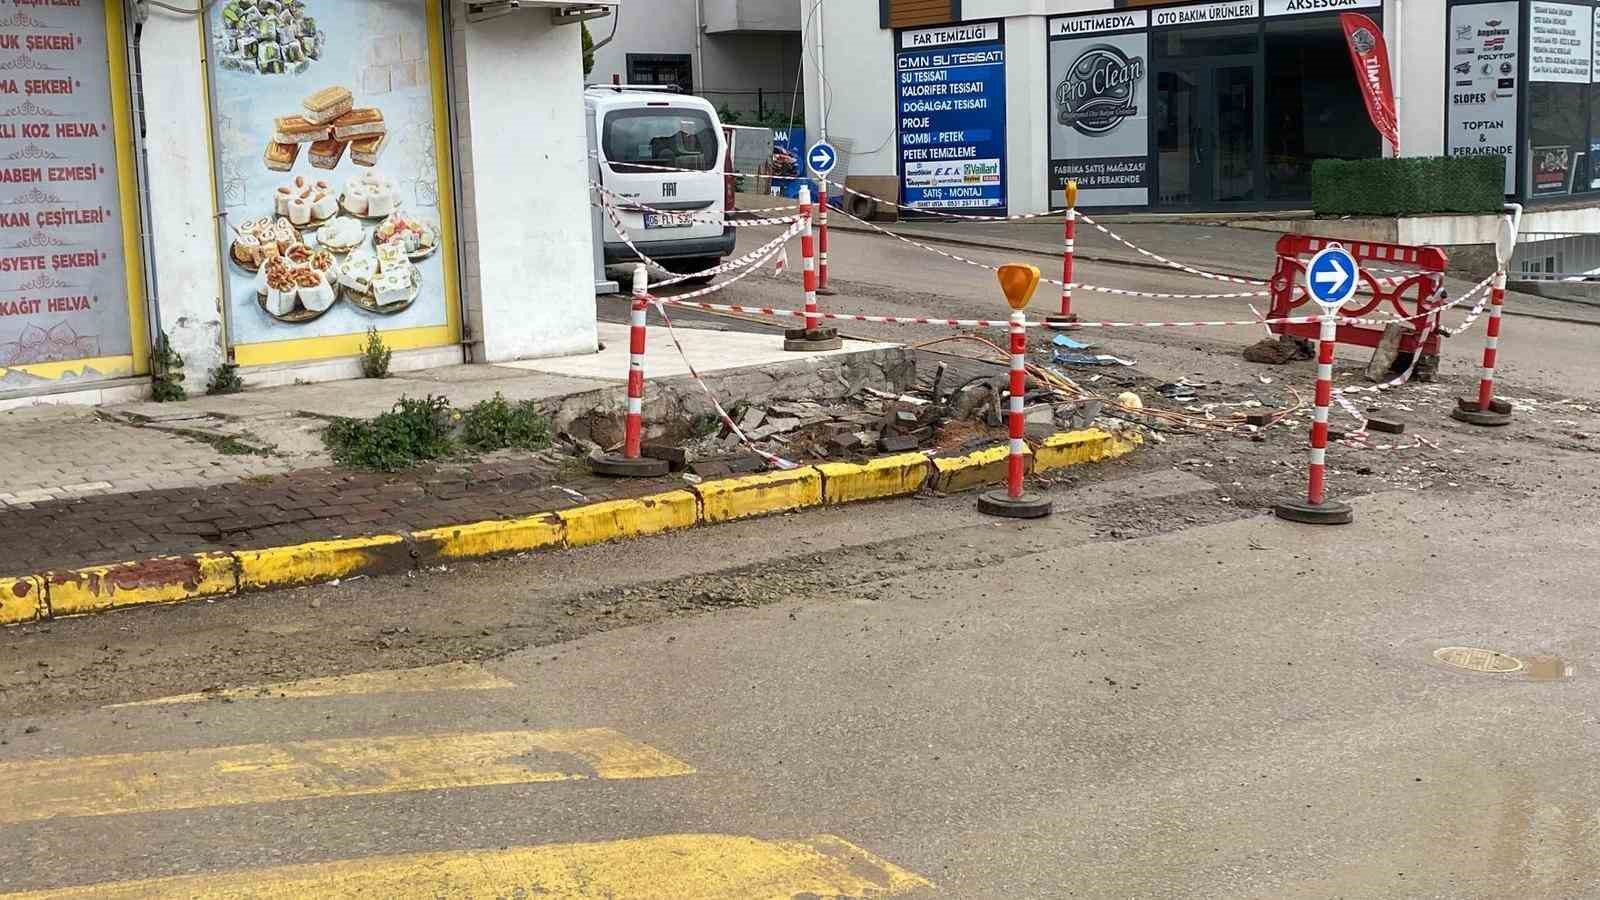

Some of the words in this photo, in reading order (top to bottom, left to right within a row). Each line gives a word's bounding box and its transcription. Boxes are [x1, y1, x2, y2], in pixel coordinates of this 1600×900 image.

[1157, 13, 1177, 25] OTO
[1179, 9, 1207, 22] BAKIM
[26, 33, 74, 51] ŞEKERİ
[913, 33, 932, 45] FAR
[898, 56, 929, 69] CMN
[932, 54, 951, 66] SU
[901, 72, 912, 84] SU
[1057, 81, 1088, 105] Pro
[1092, 61, 1141, 95] Clean
[25, 76, 73, 96] ŞEKERİ
[1453, 93, 1487, 104] SLOPES
[902, 117, 930, 129] PROJE
[1461, 120, 1504, 130] TOPTAN
[22, 123, 50, 138] KOZ
[55, 122, 99, 138] HELVA
[939, 131, 964, 142] PETEK
[1479, 133, 1486, 142] &
[903, 149, 928, 160] PETEK
[1453, 145, 1513, 156] PERAKENDE
[47, 163, 97, 181] EZMESİ
[1097, 174, 1141, 184] PERAKENDE
[662, 182, 678, 197] FIAT
[949, 187, 983, 198] MONTAJ
[52, 249, 99, 271] ŞEKERİ
[48, 295, 91, 313] HELVA
